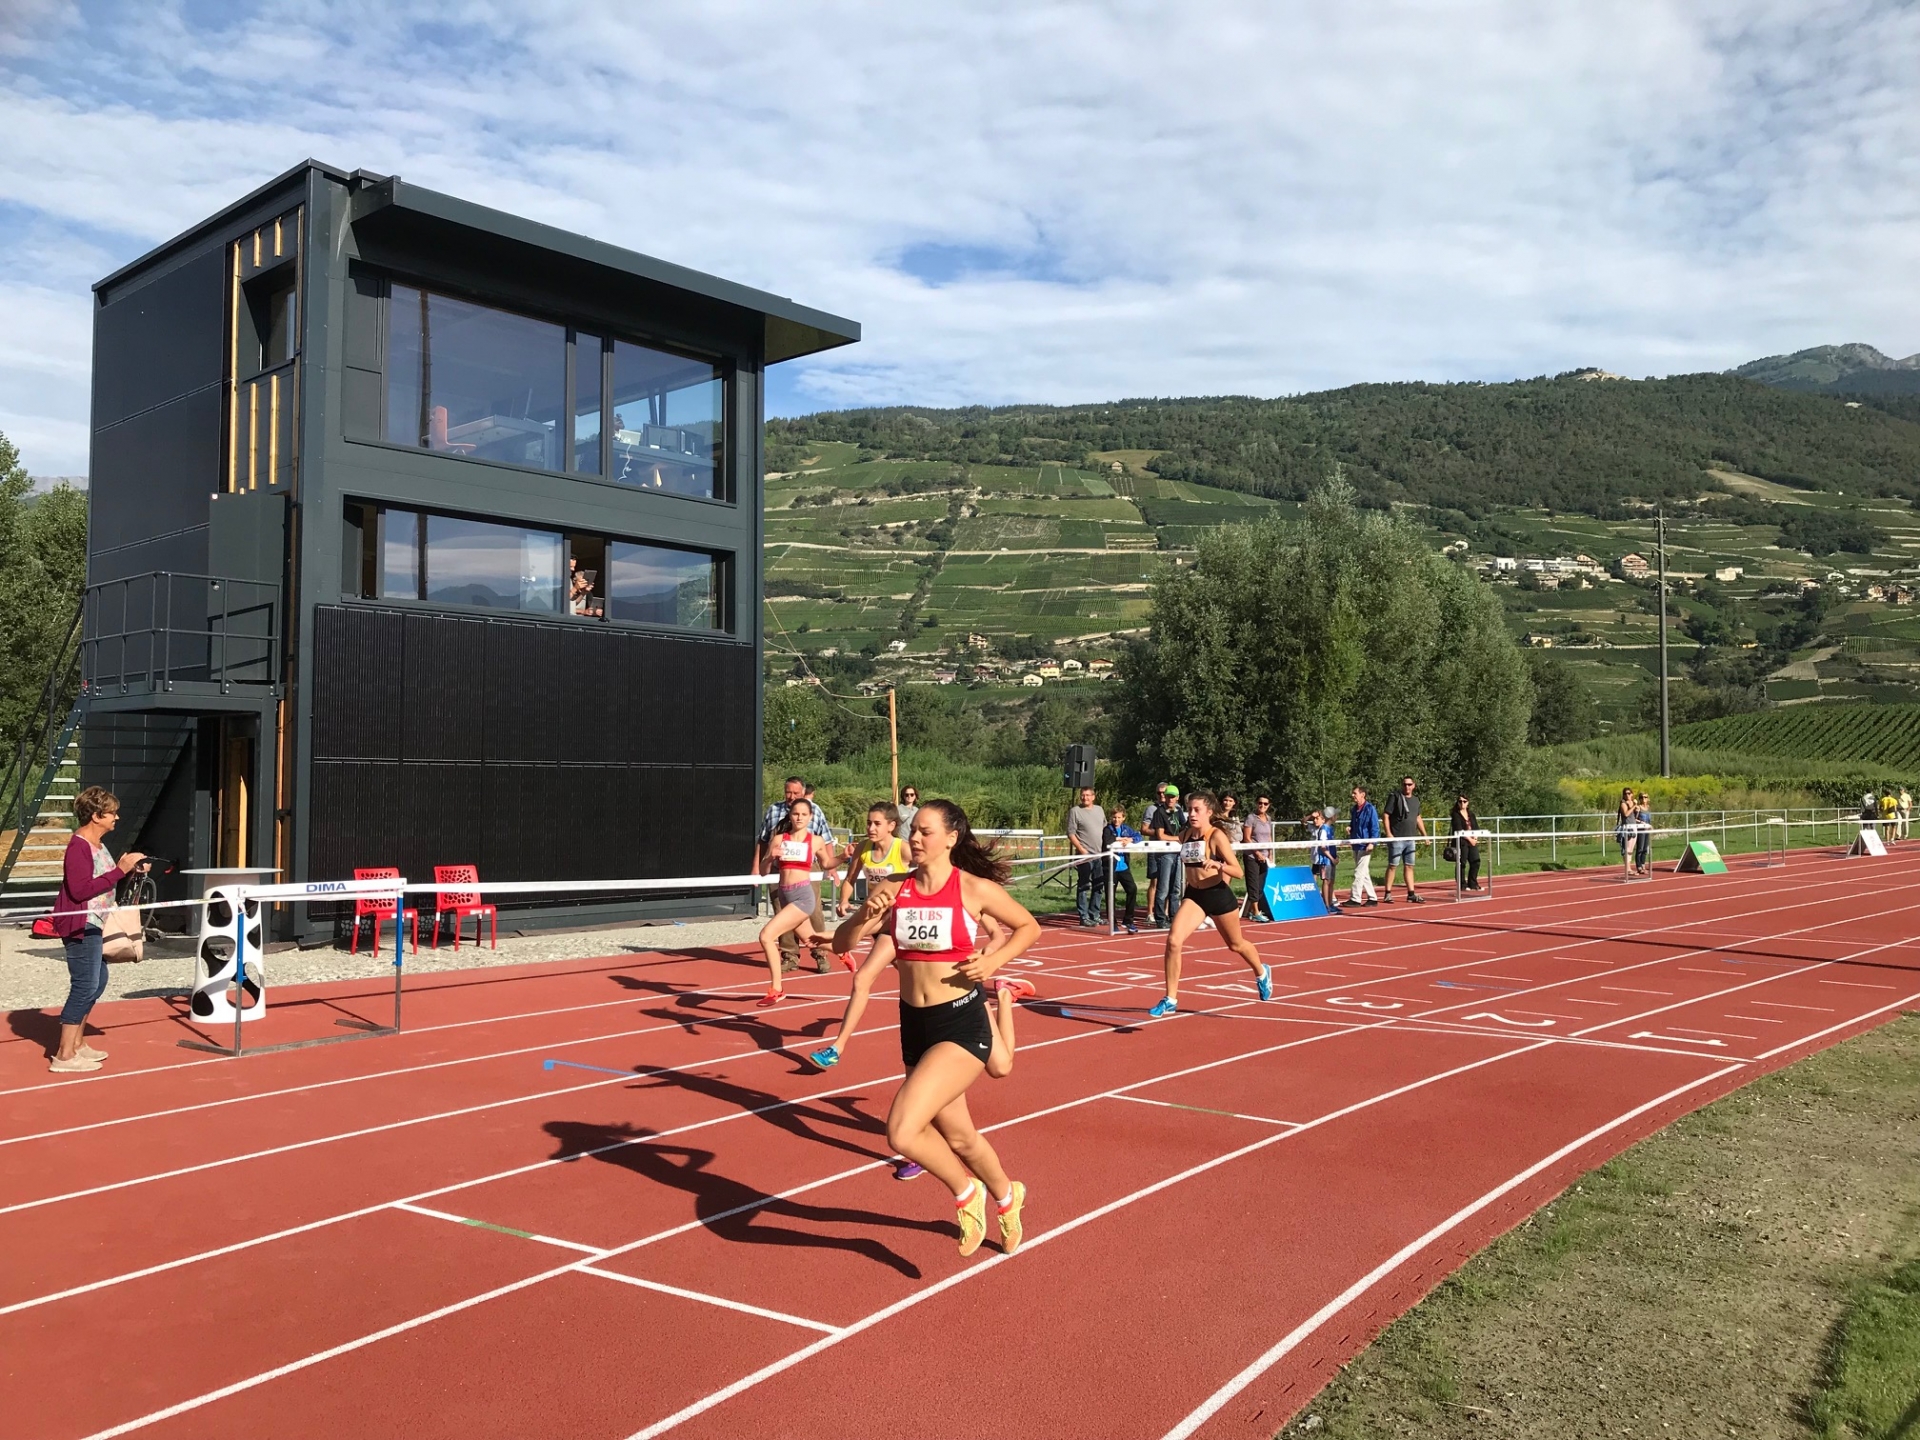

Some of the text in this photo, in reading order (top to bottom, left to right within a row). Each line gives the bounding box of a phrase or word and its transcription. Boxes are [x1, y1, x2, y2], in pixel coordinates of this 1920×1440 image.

[306, 882, 347, 893] DIMA
[919, 910, 943, 921] UBS
[908, 925, 938, 940] 264
[1087, 968, 1157, 981] 5
[952, 996, 970, 1008] NIKE
[1325, 996, 1405, 1010] 3
[1460, 1012, 1557, 1027] 2
[1627, 1030, 1729, 1047] 1
